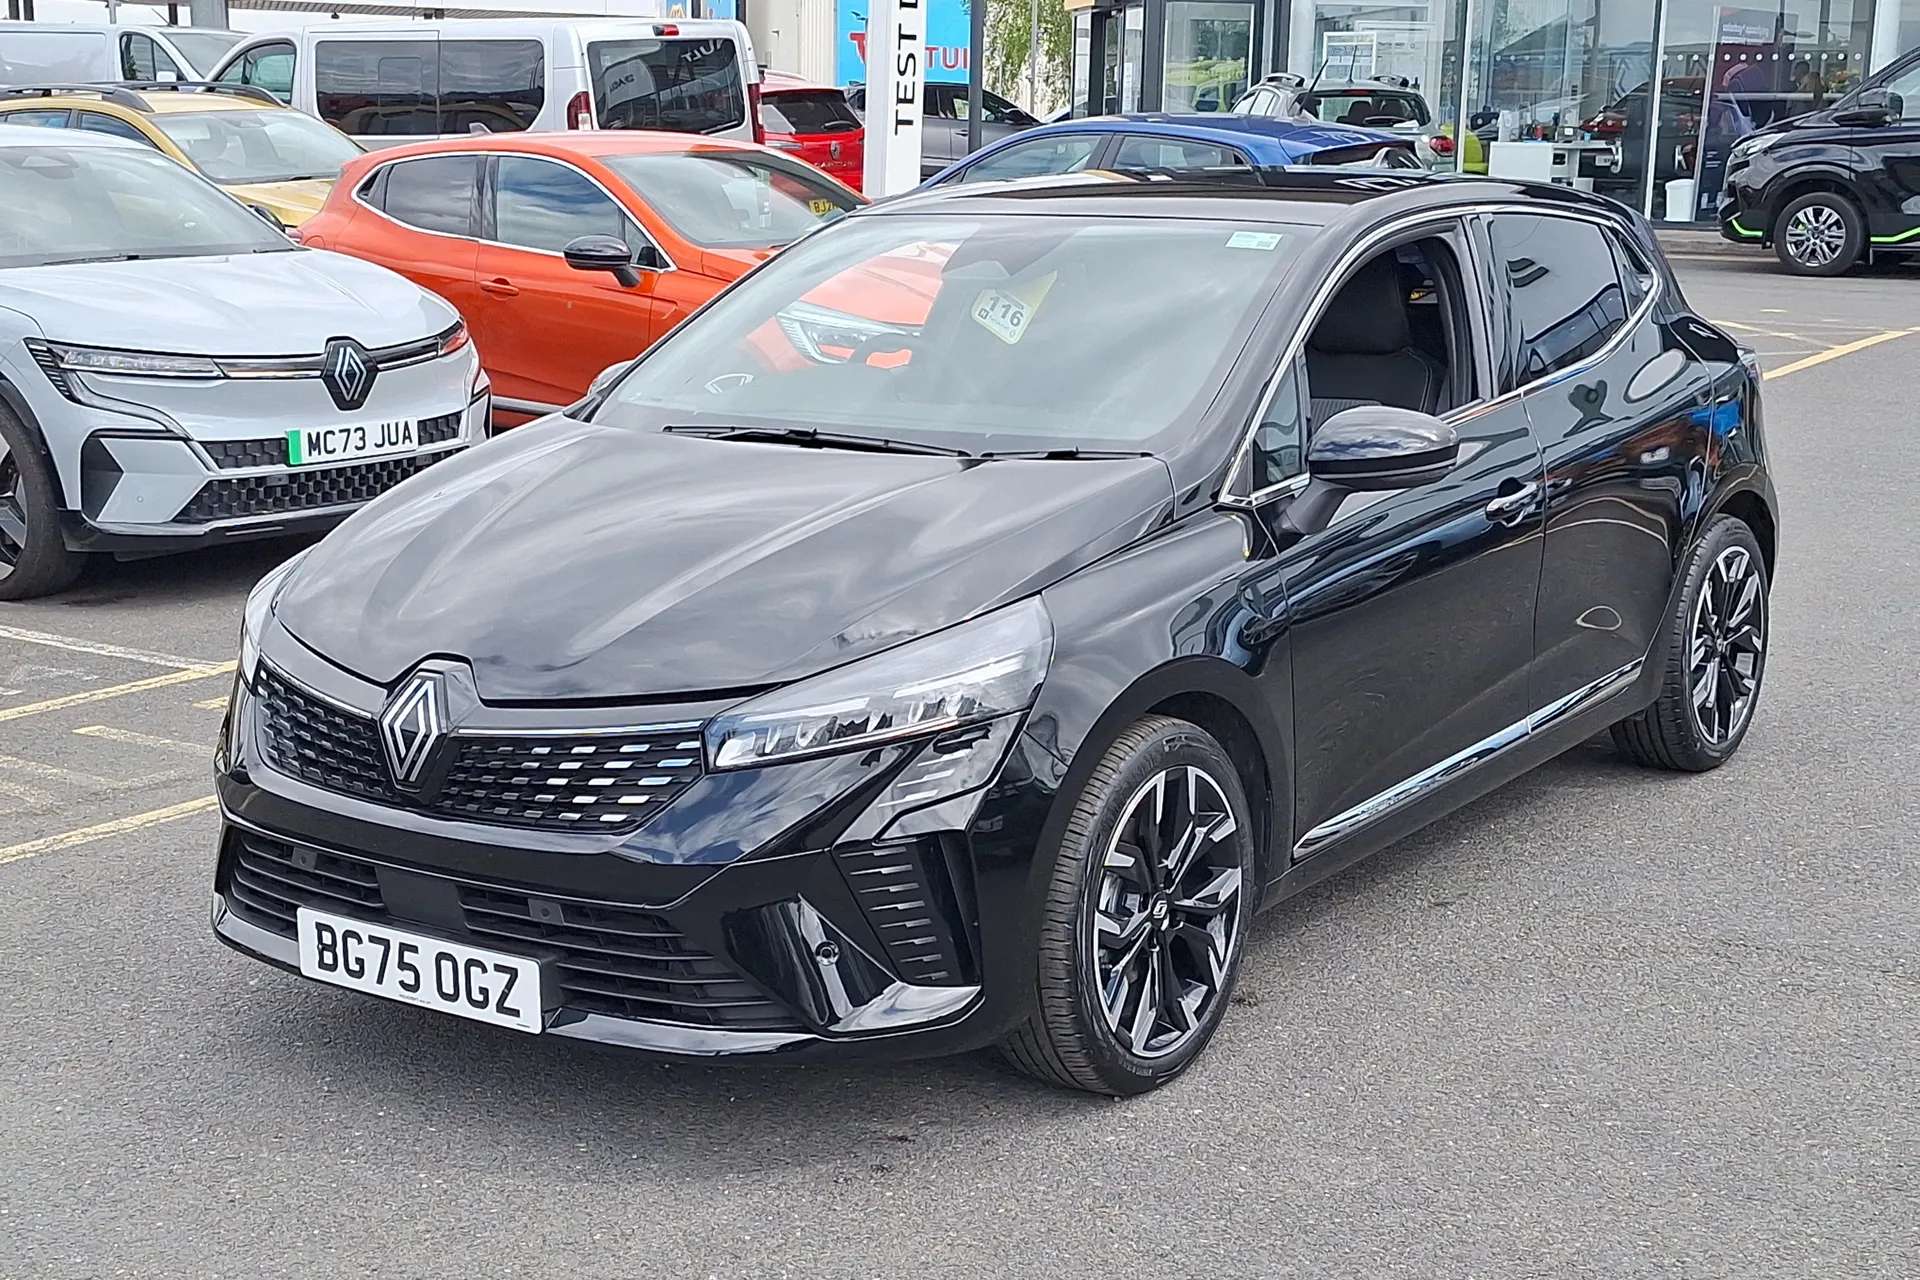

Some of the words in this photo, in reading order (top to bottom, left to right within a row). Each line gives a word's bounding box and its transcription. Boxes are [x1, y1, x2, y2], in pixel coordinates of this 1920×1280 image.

[924, 46, 968, 70] TUI
[894, 23, 917, 136] TEST
[989, 296, 1024, 327] 116
[307, 427, 366, 457] MC73
[374, 420, 413, 448] JUA
[315, 921, 421, 993] BG75
[435, 951, 521, 1018] OGZ
